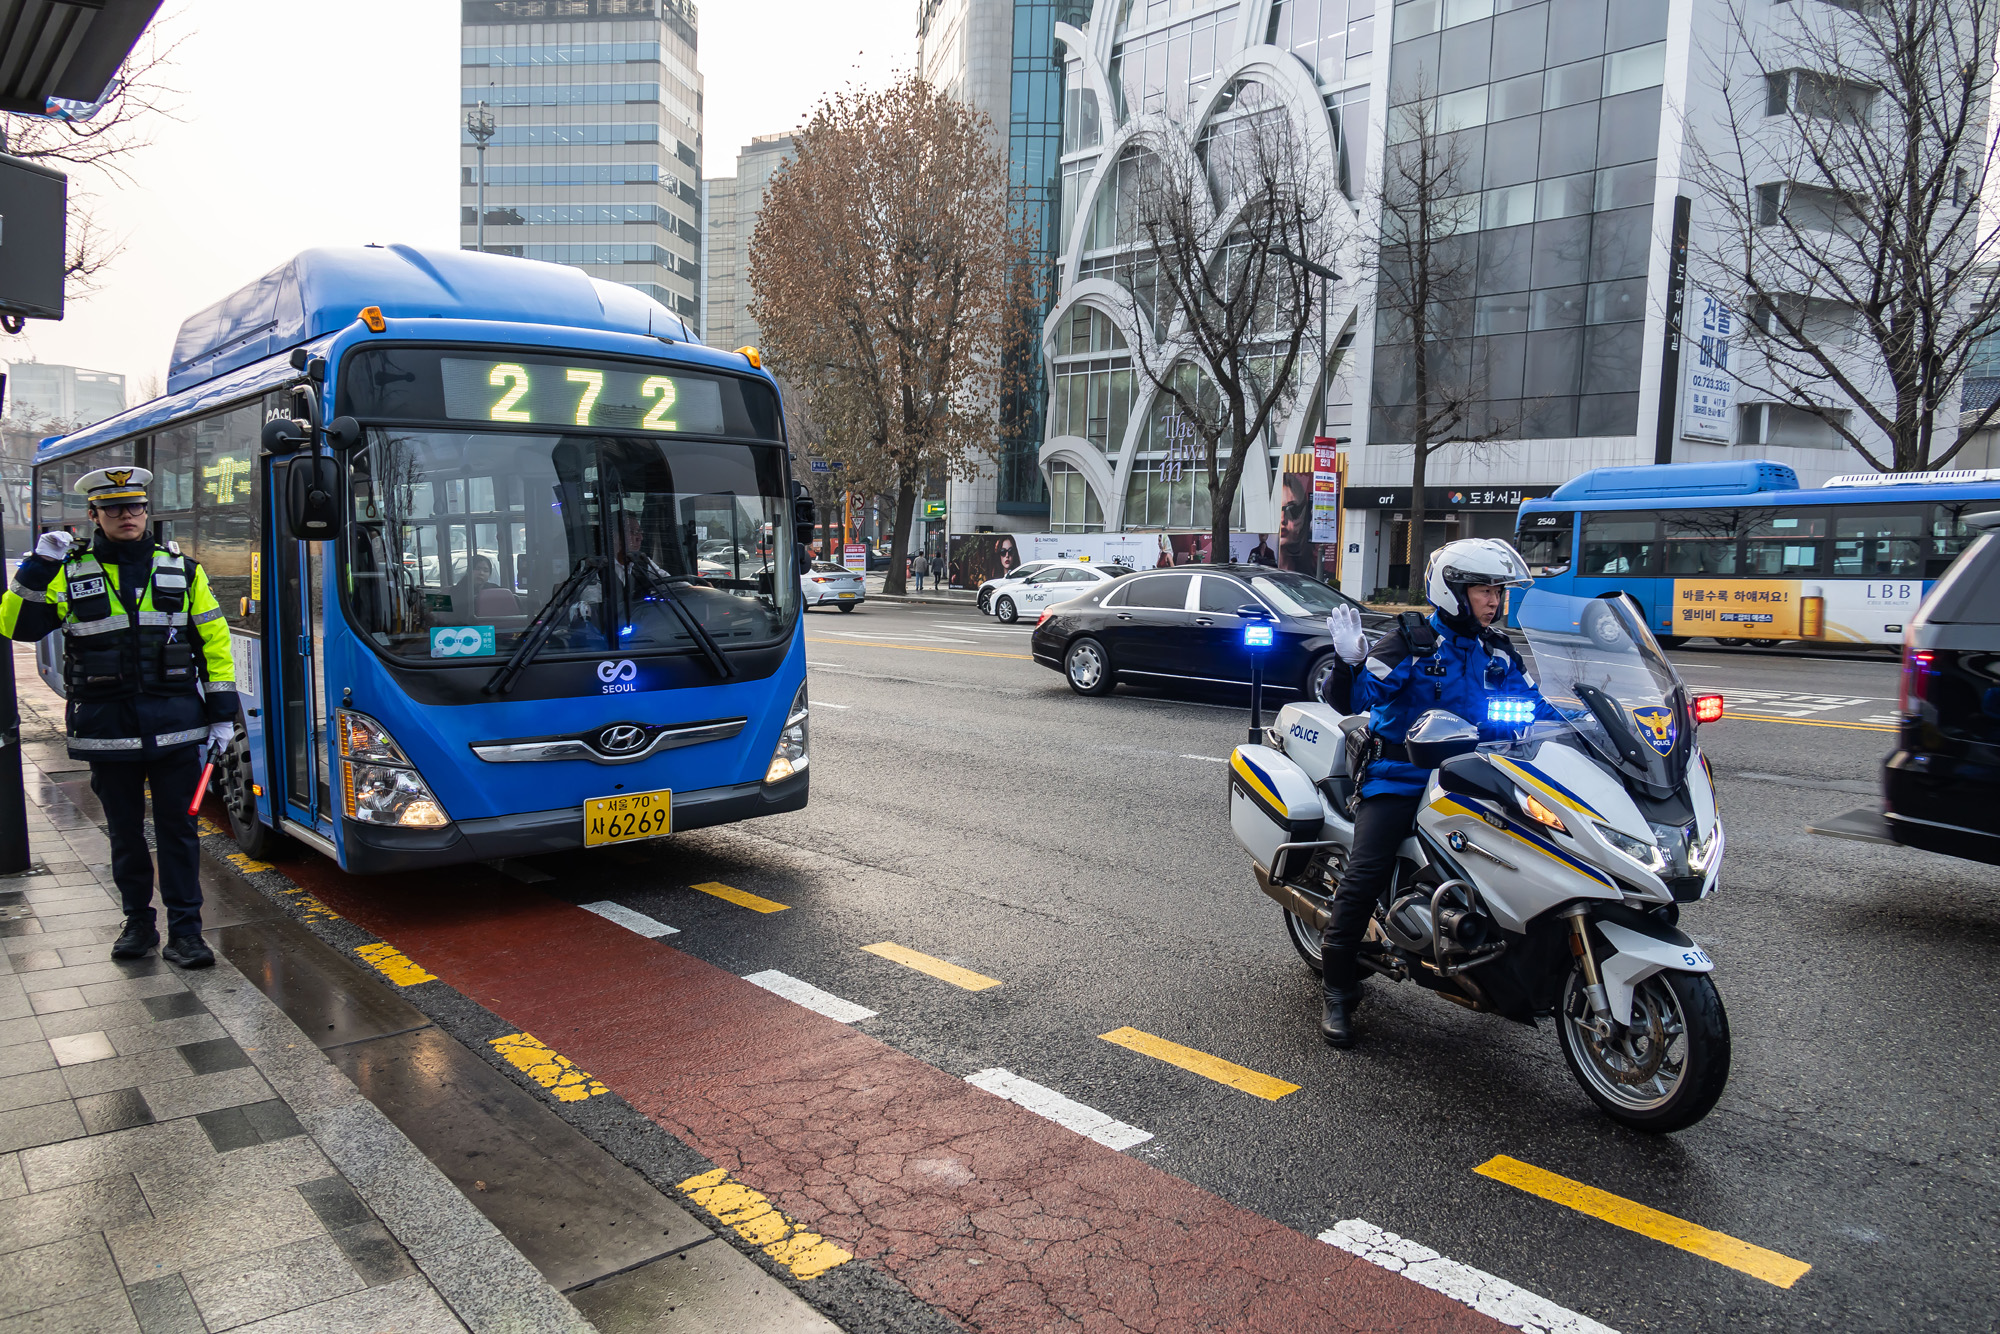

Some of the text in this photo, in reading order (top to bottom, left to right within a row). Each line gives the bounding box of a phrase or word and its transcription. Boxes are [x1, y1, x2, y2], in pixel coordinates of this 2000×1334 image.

[1161, 411, 1195, 439] The
[1379, 494, 1394, 504] art
[1469, 490, 1522, 505] 도화서길
[1537, 517, 1557, 526] 2540
[1682, 589, 1729, 602] 바를수록
[602, 684, 637, 694] SEOUL
[1289, 723, 1319, 744] POLICE
[607, 796, 650, 812] 서울 70
